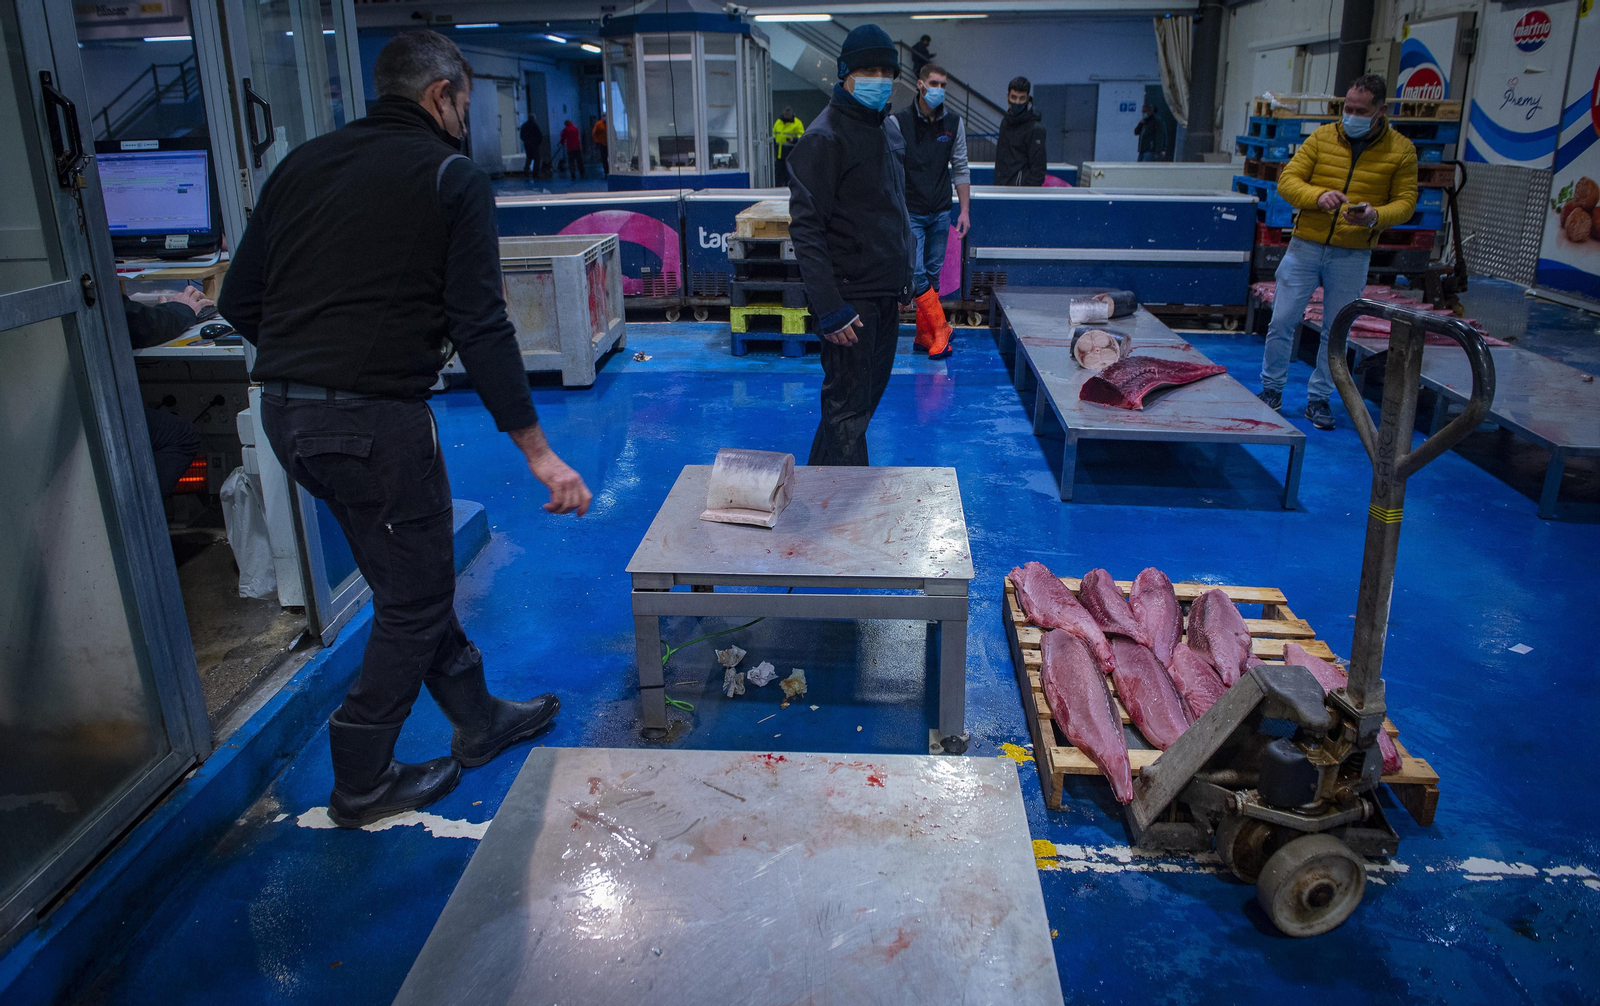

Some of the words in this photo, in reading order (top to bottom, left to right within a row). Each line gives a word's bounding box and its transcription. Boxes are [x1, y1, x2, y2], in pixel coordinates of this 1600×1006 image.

[1514, 19, 1551, 37] marfrío
[1404, 81, 1442, 100] marfrío
[1499, 89, 1543, 120] Premy
